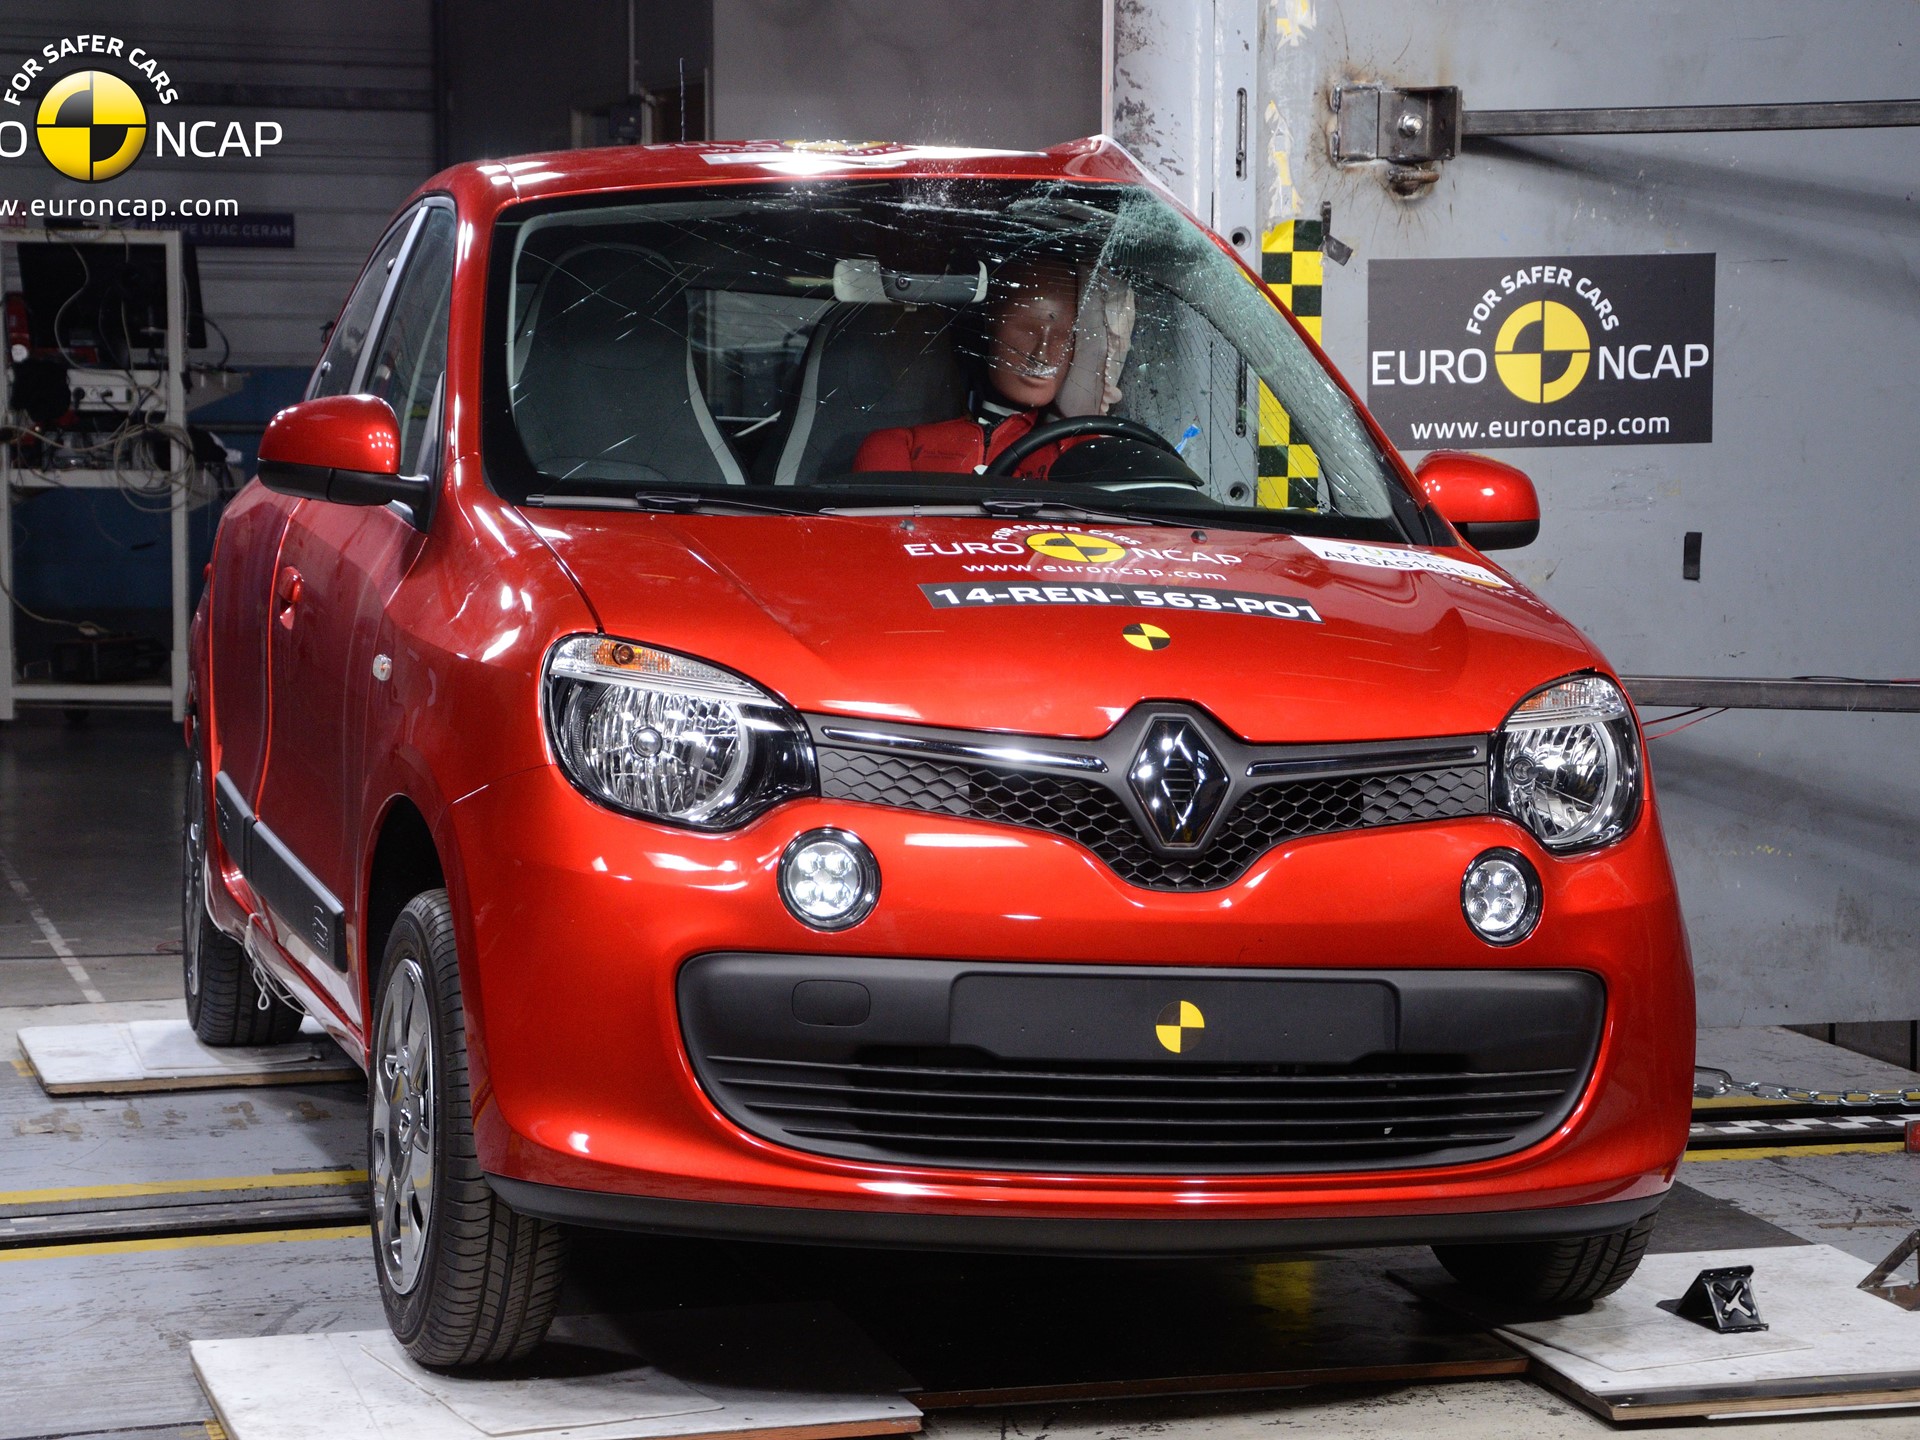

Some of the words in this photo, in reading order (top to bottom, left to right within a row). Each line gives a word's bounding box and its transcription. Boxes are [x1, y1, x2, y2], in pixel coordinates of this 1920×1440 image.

[1465, 288, 1502, 335] FOR
[1501, 265, 1573, 295] SAFER
[1575, 277, 1620, 331] CARS
[1371, 348, 1488, 386] EURO
[1597, 343, 1710, 381] NCAP
[1410, 416, 1671, 440] www.euroncap.com
[991, 527, 1018, 541] FOR
[1016, 524, 1082, 532] SAFER
[1088, 529, 1143, 546] CARS
[903, 542, 1025, 557] EURO
[1130, 547, 1243, 566] NCAP
[962, 563, 1228, 581] www.euroncap.com
